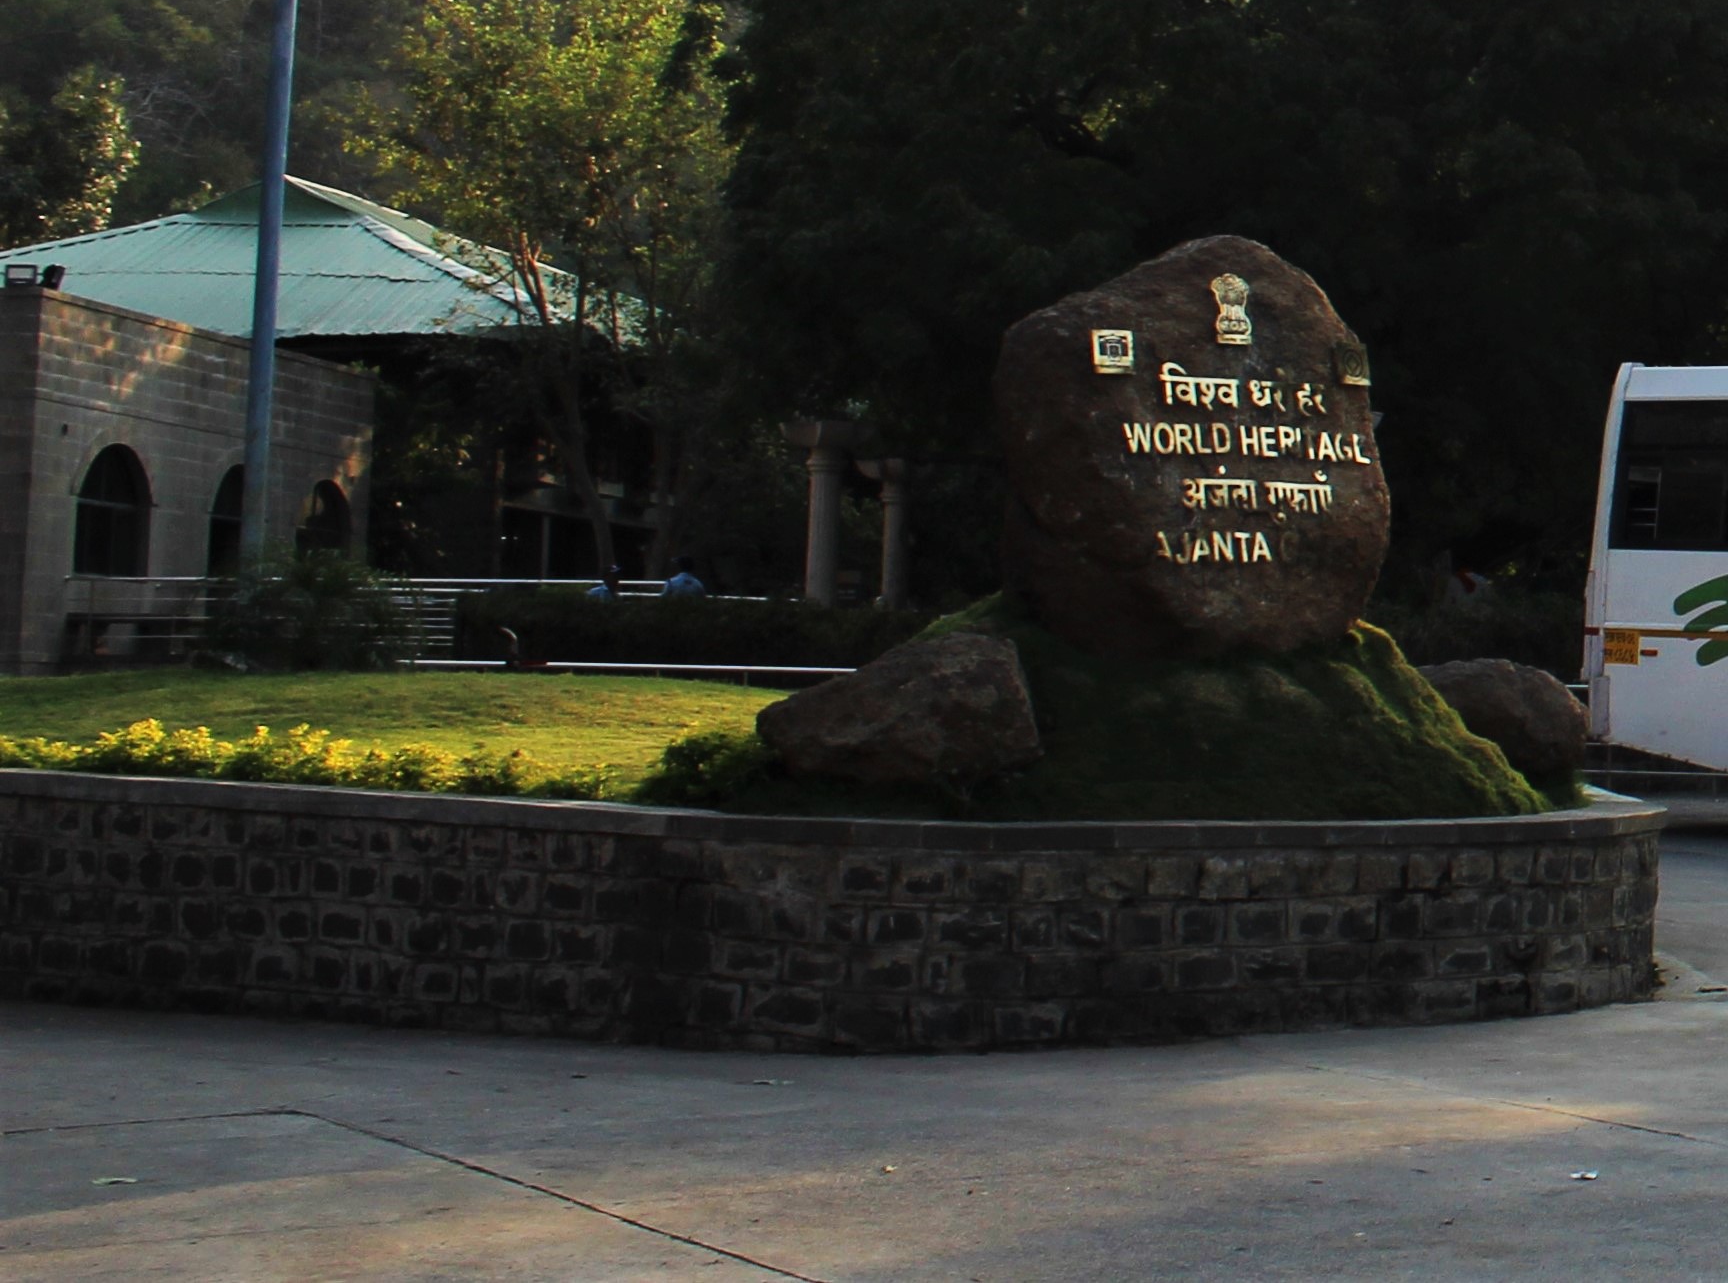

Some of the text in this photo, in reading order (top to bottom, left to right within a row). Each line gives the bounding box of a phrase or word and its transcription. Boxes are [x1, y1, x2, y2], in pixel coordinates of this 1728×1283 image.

[1159, 361, 1240, 410] विश्व
[1123, 422, 1232, 455] WORLD
[1182, 464, 1258, 510] अजंता
[1156, 531, 1273, 565] AJANTA
